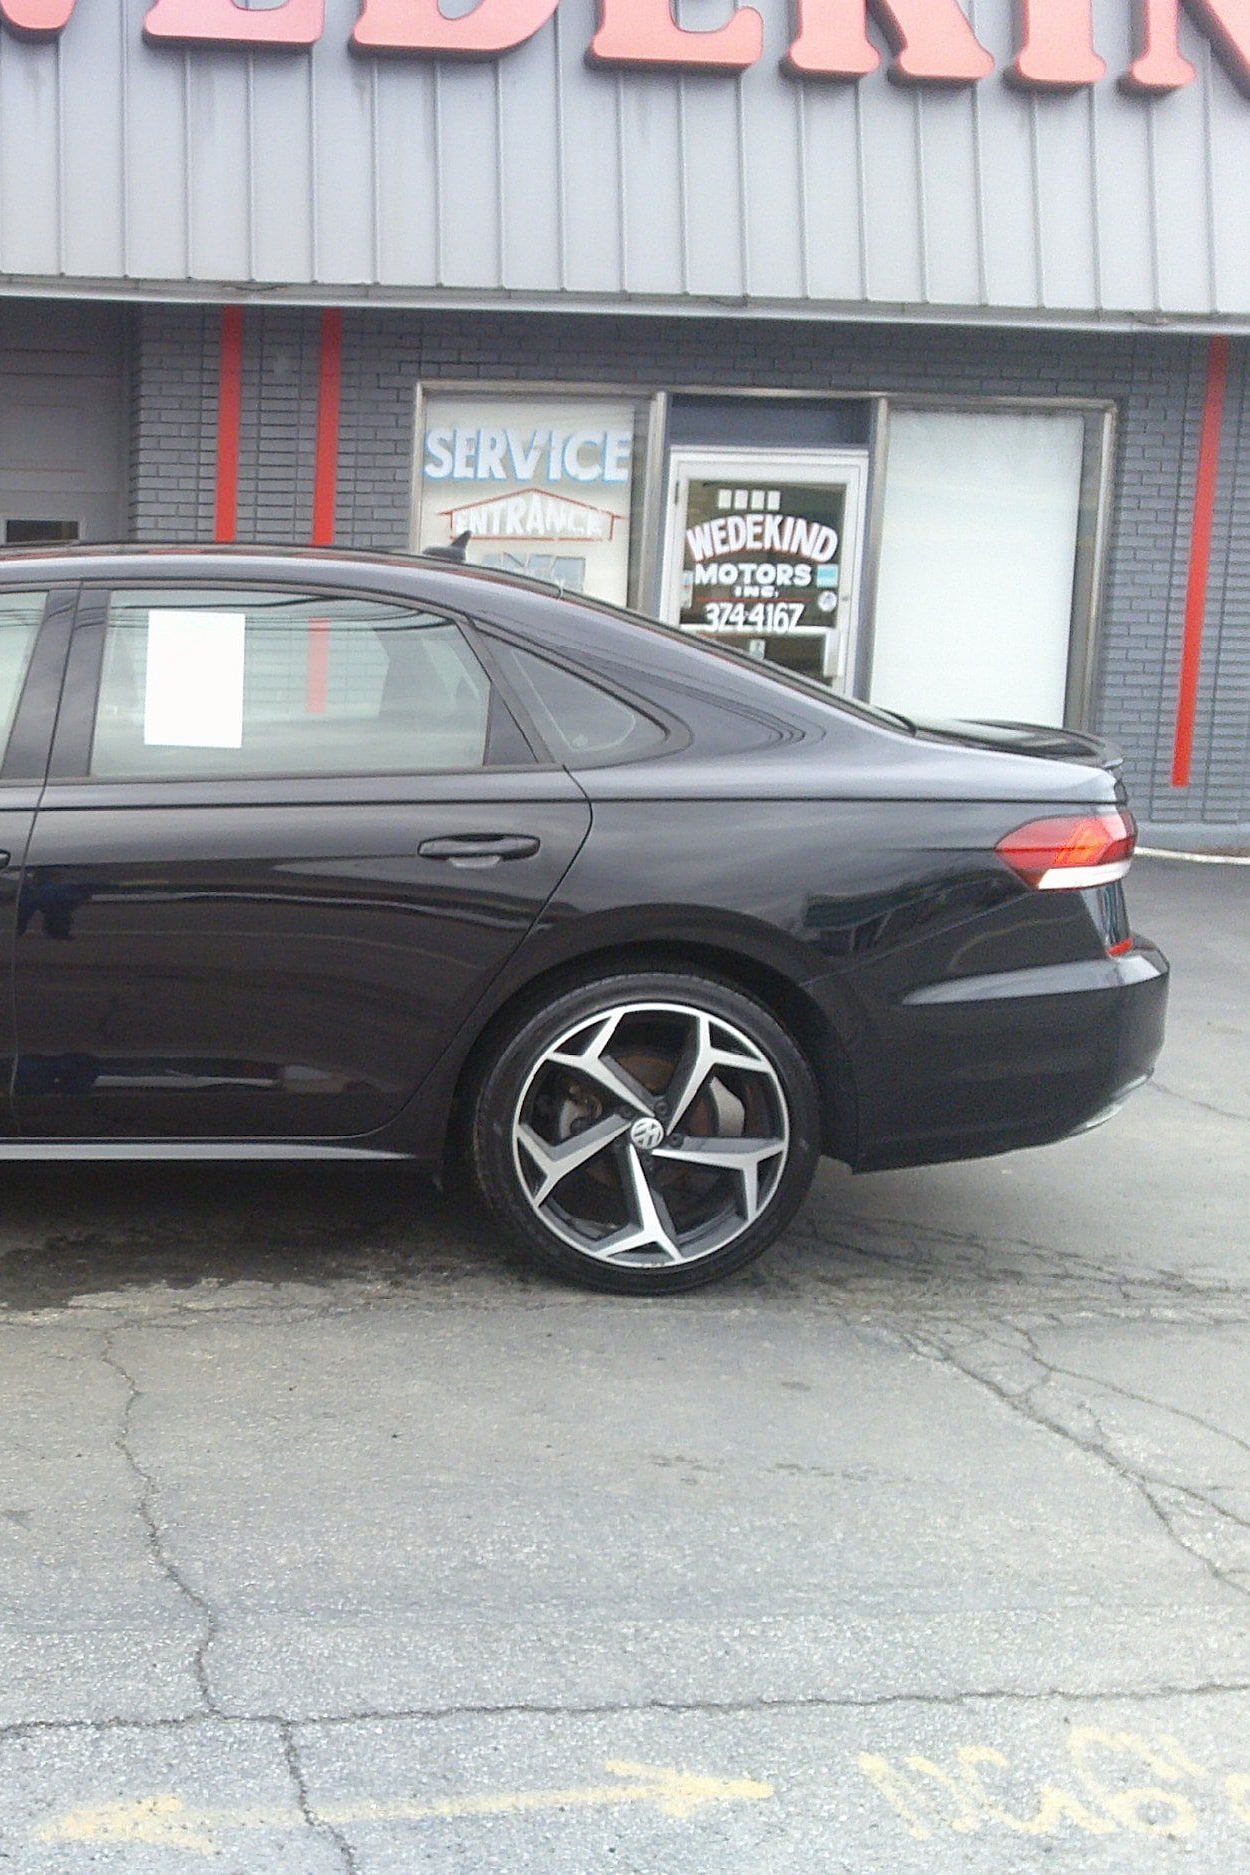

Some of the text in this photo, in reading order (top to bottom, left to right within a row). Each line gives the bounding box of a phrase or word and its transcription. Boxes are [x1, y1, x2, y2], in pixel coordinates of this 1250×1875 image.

[423, 427, 633, 483] SERVICE
[454, 493, 603, 537] ENTRANCE
[686, 512, 839, 564] WEDEKIND
[694, 561, 813, 587] MOTORS
